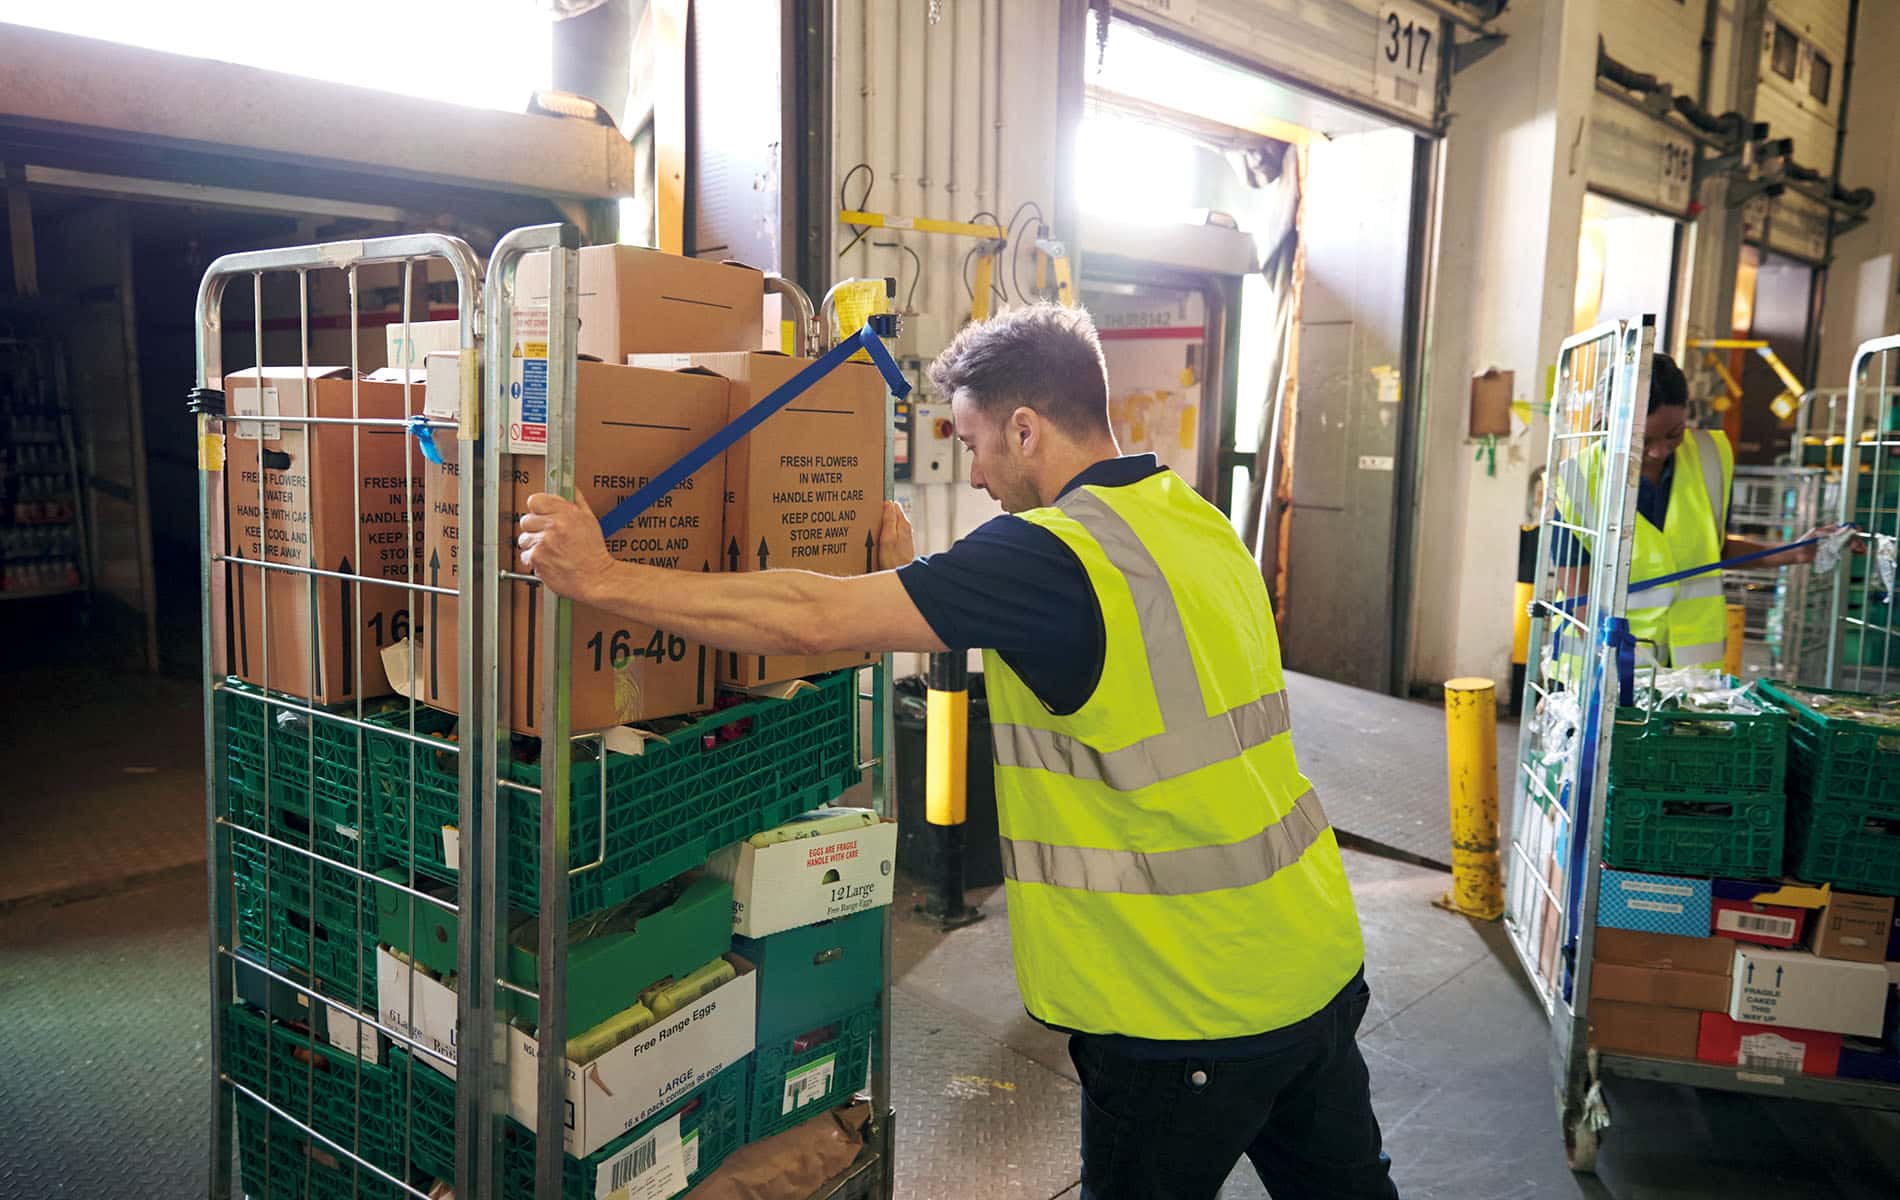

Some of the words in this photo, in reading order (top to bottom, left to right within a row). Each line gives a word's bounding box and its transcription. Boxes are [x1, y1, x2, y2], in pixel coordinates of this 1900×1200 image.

[1385, 11, 1431, 75] 317
[780, 456, 813, 468] FRESH
[815, 456, 858, 468] FLOWERS
[270, 474, 307, 488] FLOWERS
[364, 477, 408, 489] FRESH
[593, 475, 636, 489] FRESH
[800, 473, 809, 484] IN
[811, 472, 843, 484] WATER
[266, 489, 293, 503] WATER
[389, 493, 402, 505] IN
[772, 491, 813, 504] HANDLE
[816, 491, 839, 502] WITH
[840, 490, 864, 501] CARE
[271, 508, 291, 522] WITH
[360, 511, 408, 523] HANDLE
[637, 515, 667, 528] WITH
[669, 515, 700, 528] CARE
[782, 513, 809, 525] KEEP
[811, 511, 836, 523] COOL
[838, 510, 857, 522] AND
[267, 528, 290, 542] COOL
[291, 531, 308, 545] AND
[368, 532, 403, 545] KEEP
[790, 529, 823, 541] STORE
[824, 527, 849, 539] AWAY
[630, 539, 665, 551] COOL
[665, 538, 689, 550] AND
[791, 545, 819, 558] FROM
[822, 543, 848, 555] FRUIT
[280, 546, 302, 559] AWAY
[587, 629, 687, 673] 16-46
[808, 847, 824, 857] EGGS
[845, 849, 860, 859] CARE
[1744, 987, 1781, 997] FRAGILE
[1746, 996, 1777, 1005] CAKES
[1742, 1013, 1762, 1021] WAY
[1764, 1014, 1777, 1023] UP
[634, 1038, 657, 1057] Free
[659, 1017, 690, 1042] Range
[692, 1002, 716, 1021] Eggs
[658, 1067, 694, 1098] LARGE
[647, 1100, 666, 1117] pack
[666, 1079, 696, 1104] contains
